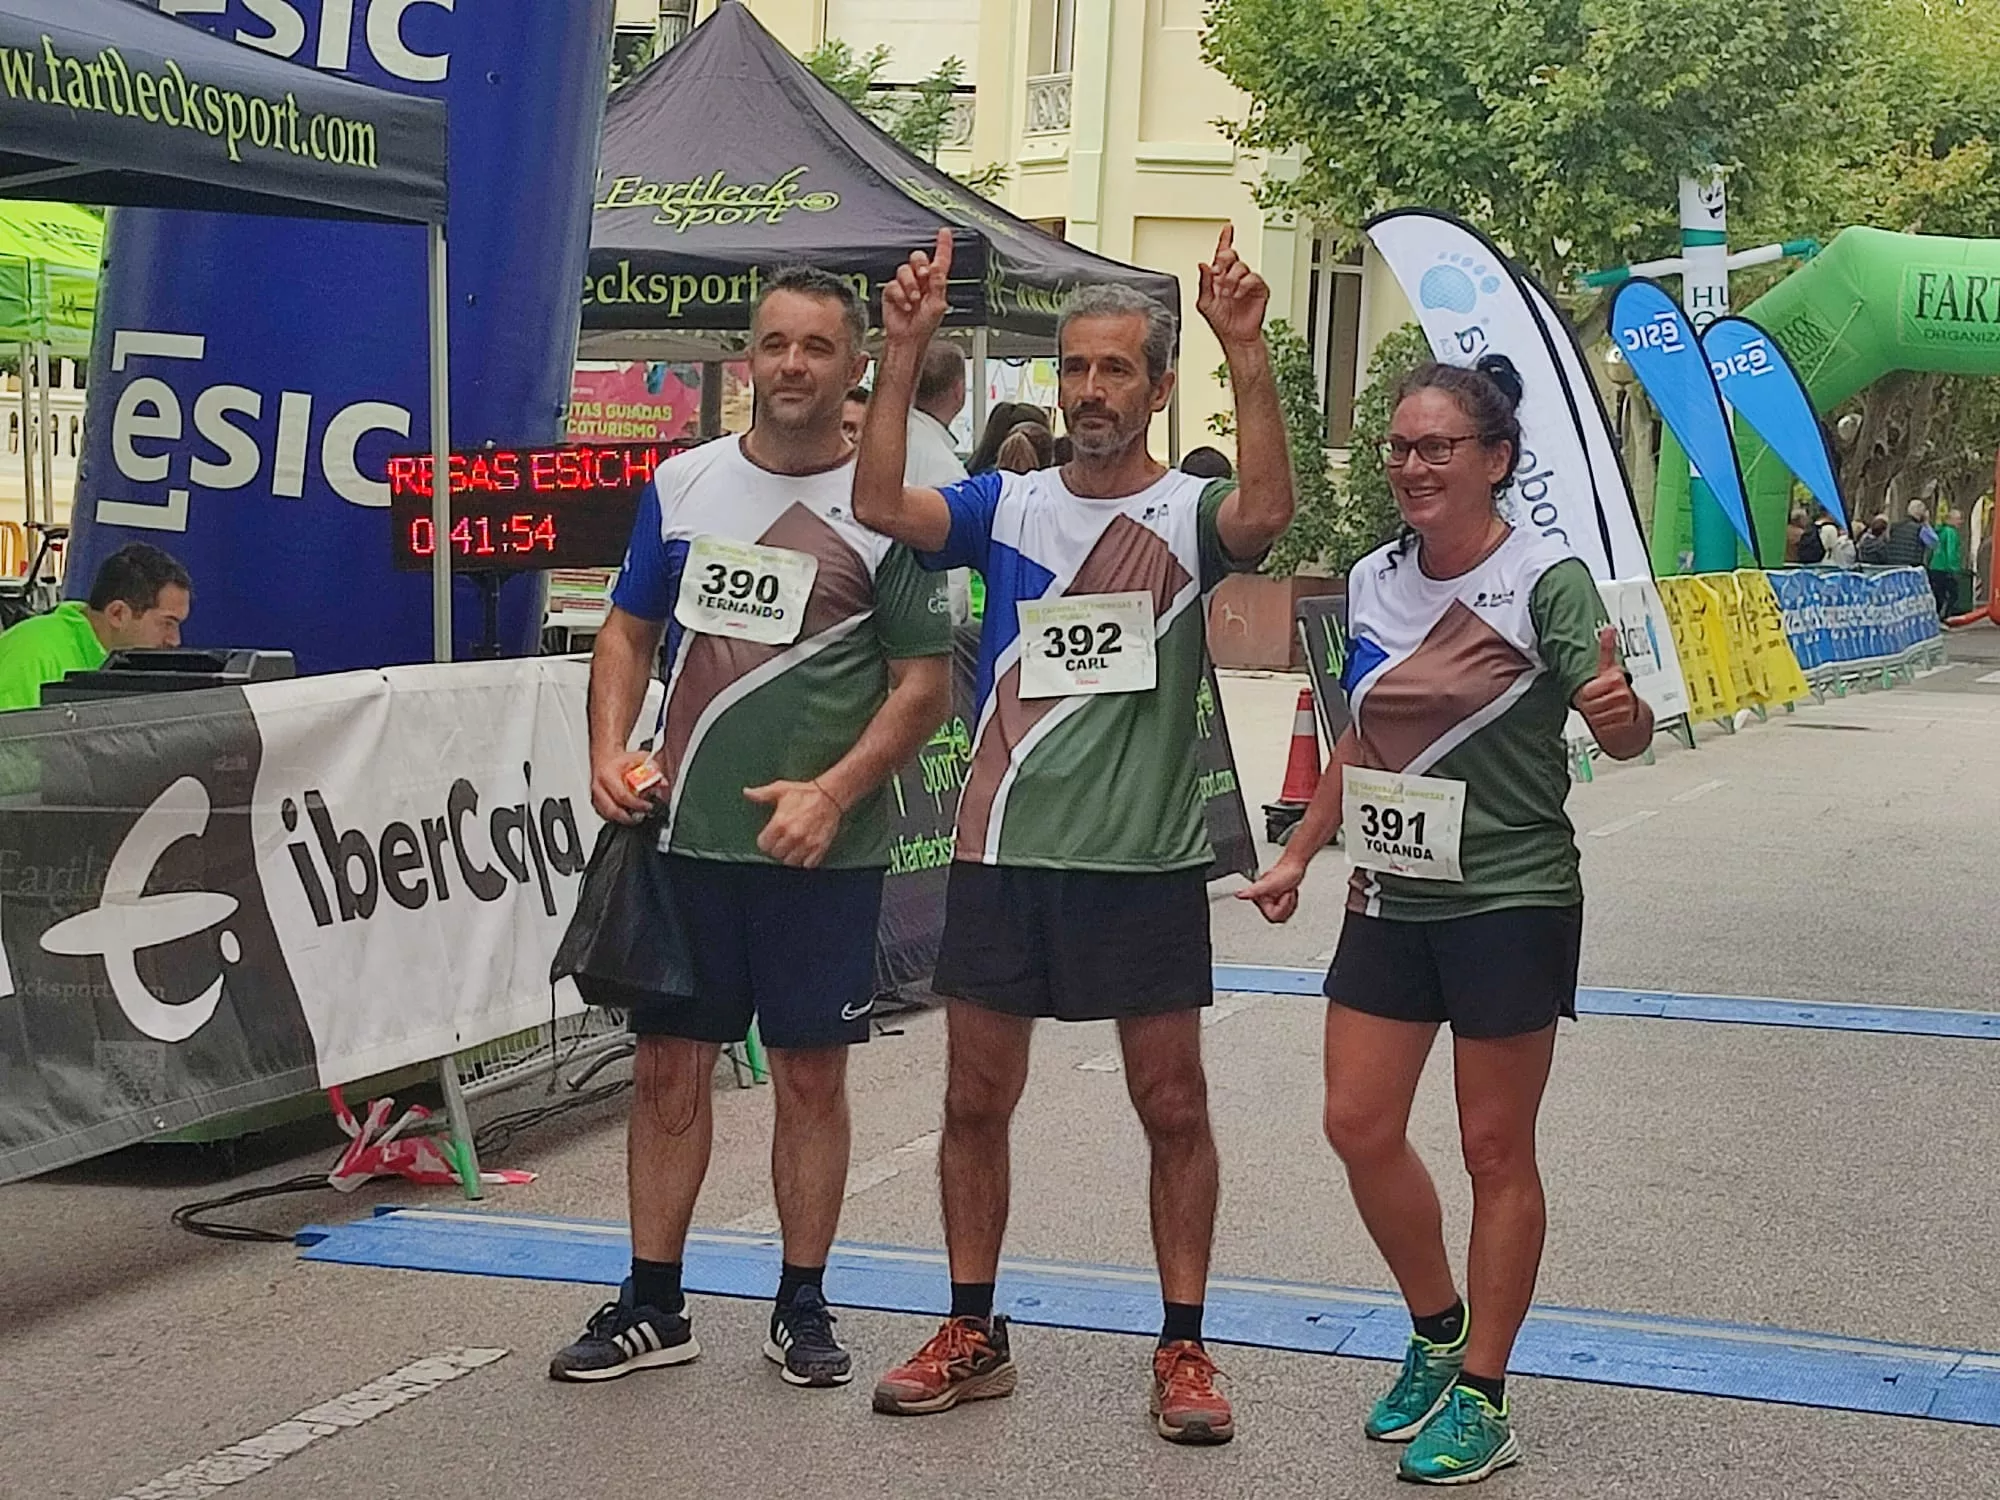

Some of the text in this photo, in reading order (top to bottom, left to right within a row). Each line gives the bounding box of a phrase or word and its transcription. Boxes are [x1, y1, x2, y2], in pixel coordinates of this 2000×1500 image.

[701, 563, 780, 604] 390
[696, 594, 785, 620] FERNANDO
[1042, 622, 1122, 658] 392
[1065, 657, 1110, 672] CARL
[1360, 804, 1426, 846] 391
[281, 761, 587, 927] iberCaja
[1364, 838, 1435, 861] YOLANDA
